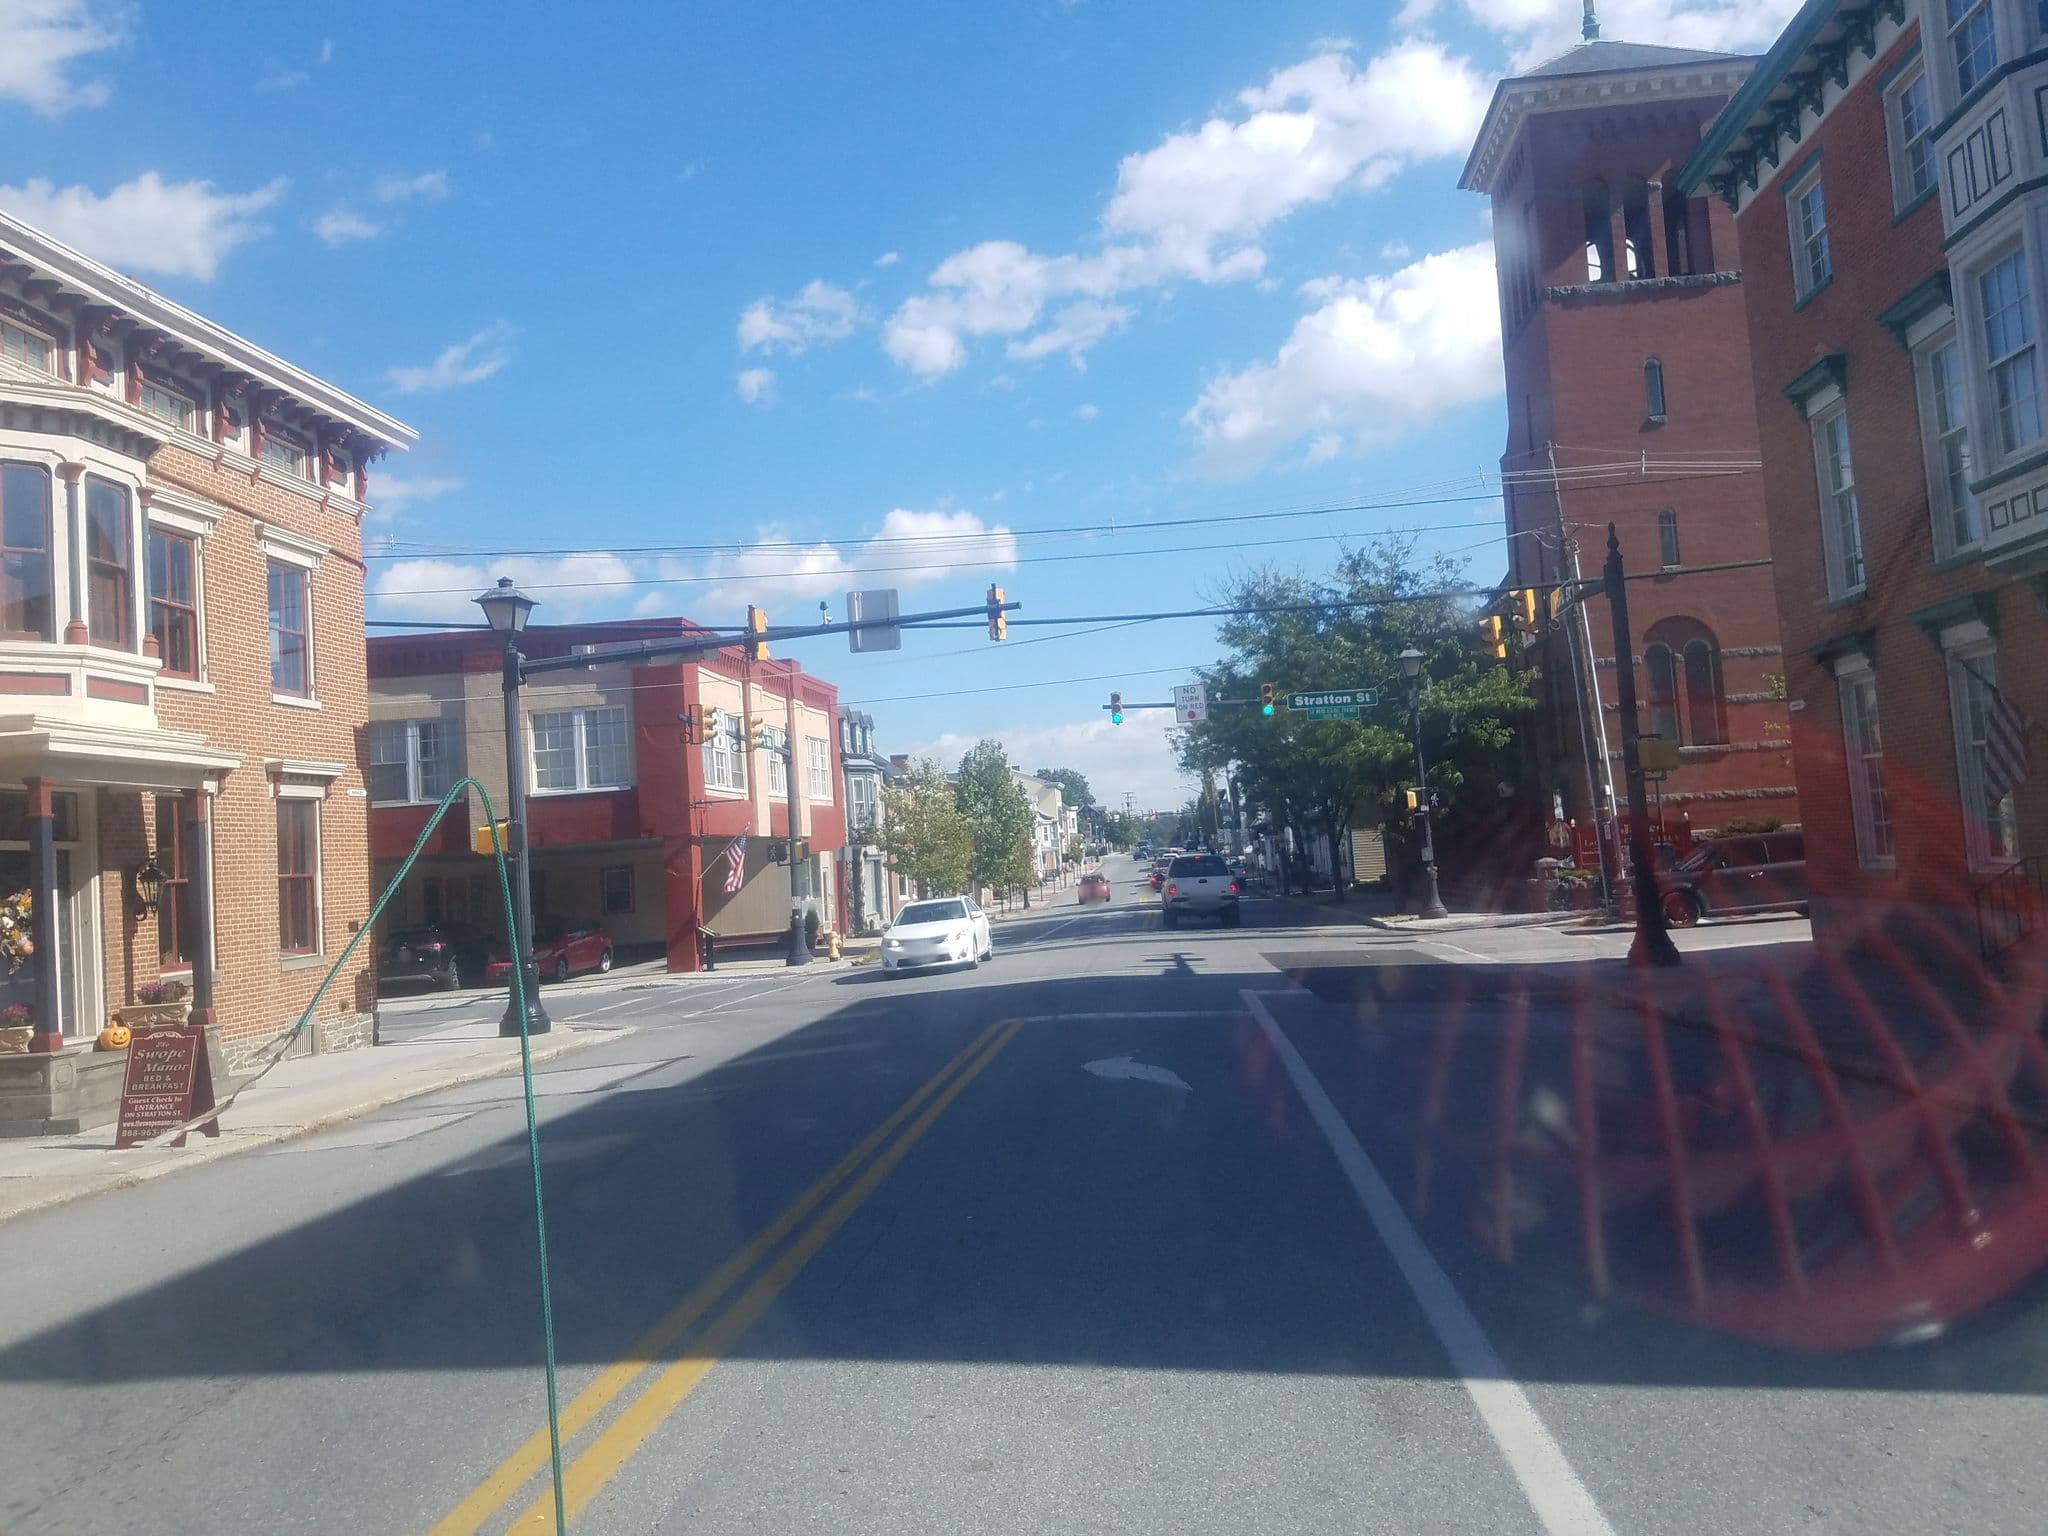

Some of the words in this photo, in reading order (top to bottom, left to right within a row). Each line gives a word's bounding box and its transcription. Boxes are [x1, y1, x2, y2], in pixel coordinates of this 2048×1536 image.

[1183, 686, 1196, 694] NO
[1294, 694, 1351, 706] Stratton
[1356, 692, 1370, 702] St
[134, 1049, 186, 1062] Swope
[144, 1063, 188, 1072] Manor
[144, 1074, 162, 1082] BED
[132, 1082, 184, 1090] BREAKFAST
[134, 1103, 174, 1111] ENTRANCE
